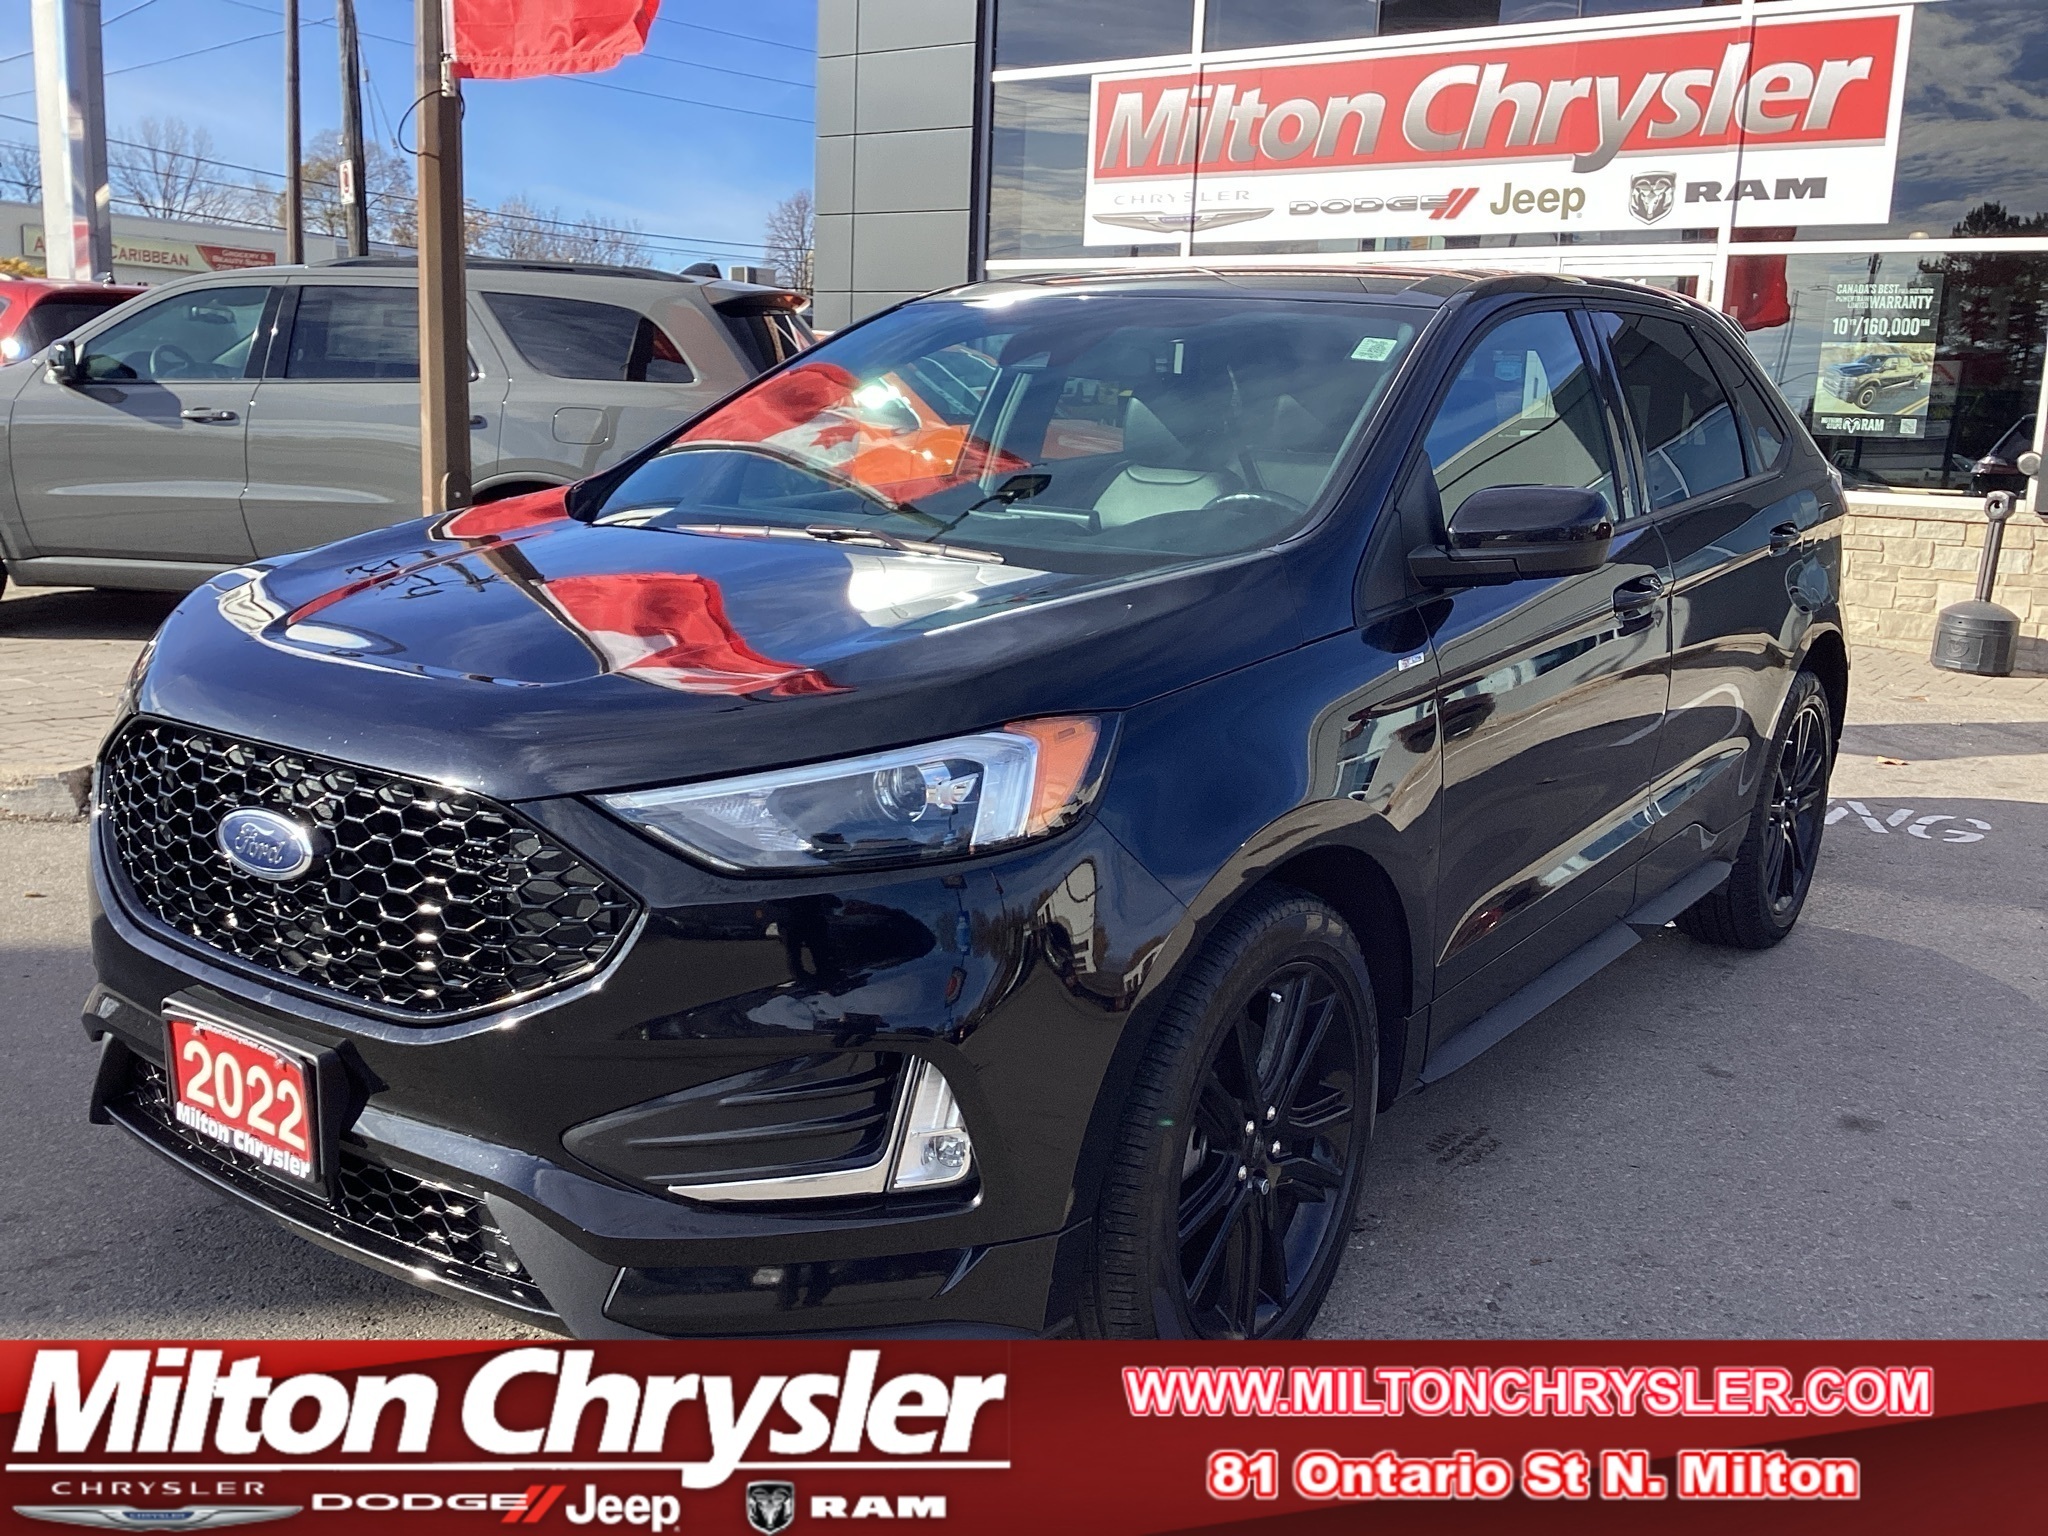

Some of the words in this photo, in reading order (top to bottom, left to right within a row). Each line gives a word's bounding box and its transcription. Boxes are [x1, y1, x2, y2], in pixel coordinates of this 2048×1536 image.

[1100, 82, 1387, 170] Milton
[1402, 42, 1874, 173] Chrysler
[1114, 190, 1250, 205] CHRYSLER
[1490, 182, 1586, 220] Jeep
[1684, 176, 1828, 203] RAM
[1288, 194, 1450, 216] DODGE
[111, 243, 189, 267] CARIBBEAN
[1836, 283, 1877, 294] CANADA'S
[1877, 283, 1900, 294] BEST
[1869, 295, 1934, 309] WARRANTY
[1861, 418, 1884, 431] RAM
[234, 822, 285, 865] Ford
[182, 1039, 307, 1151] 2022
[175, 1101, 229, 1146] Milton
[233, 1128, 311, 1181] Chrysler
